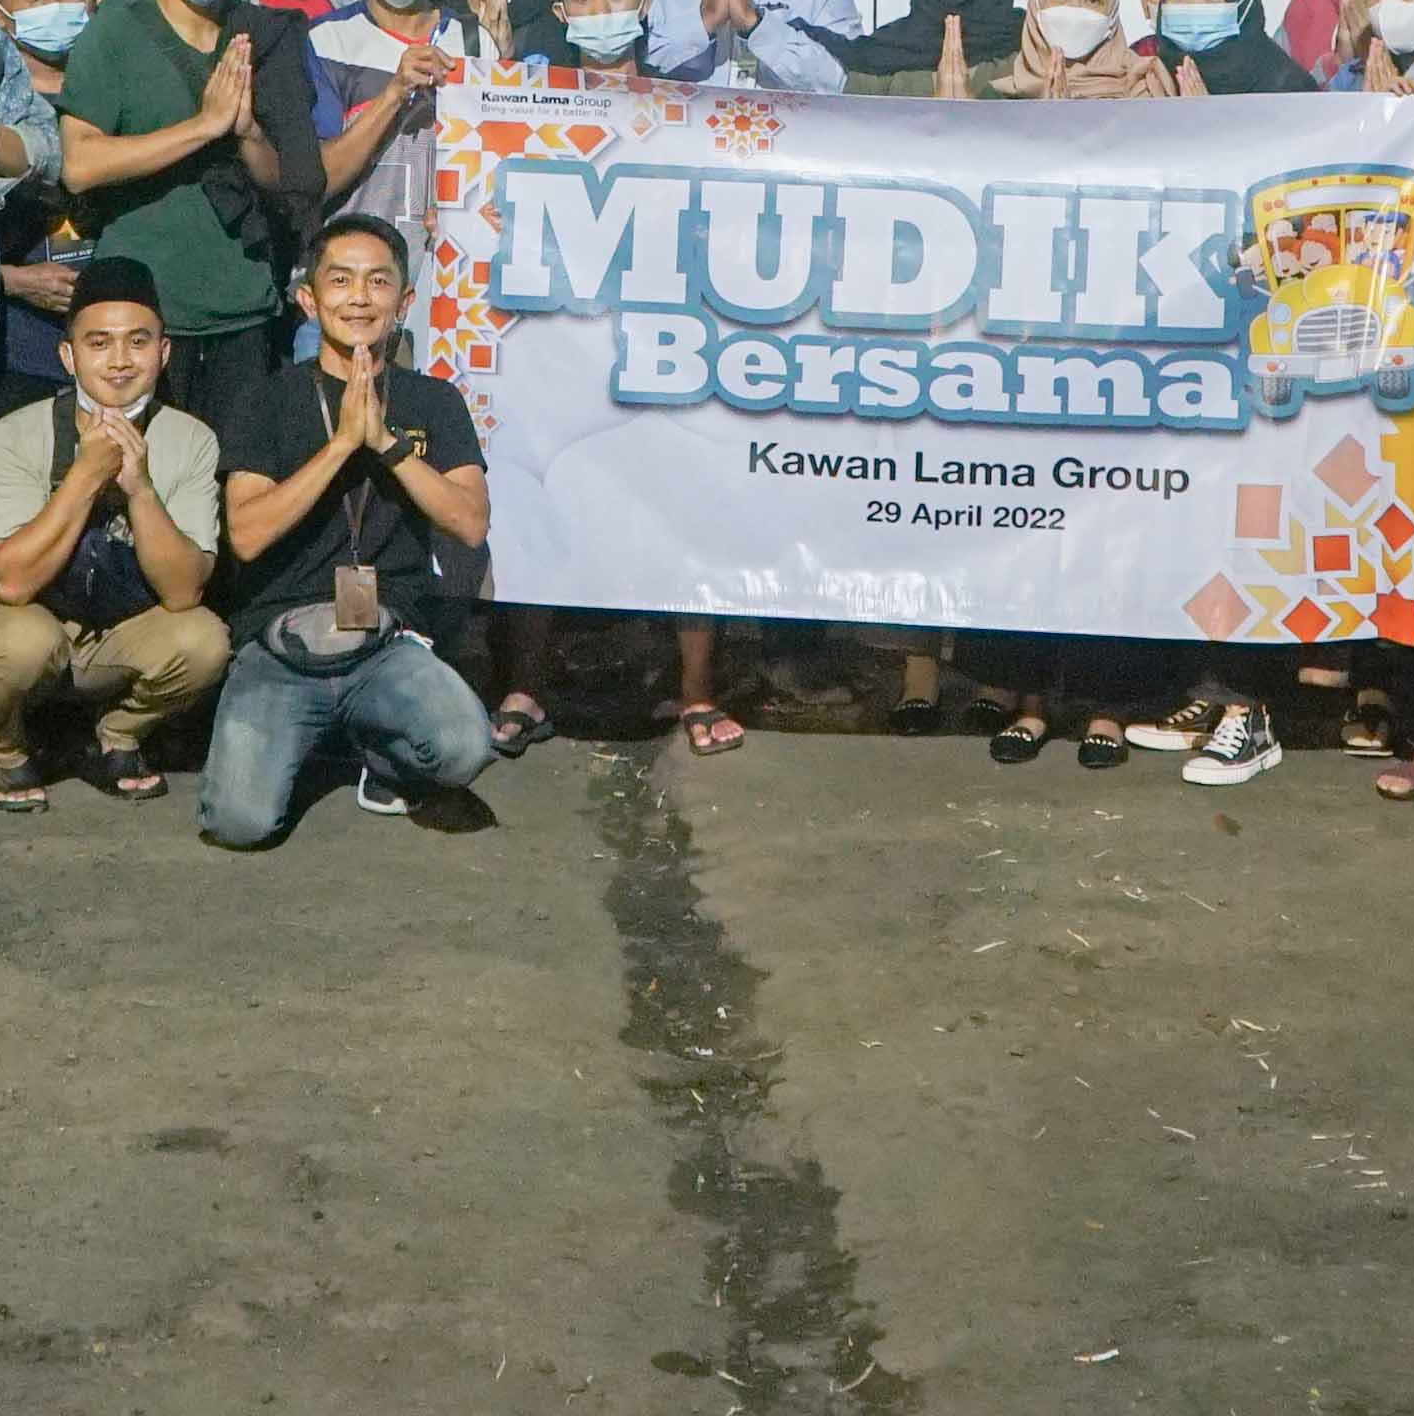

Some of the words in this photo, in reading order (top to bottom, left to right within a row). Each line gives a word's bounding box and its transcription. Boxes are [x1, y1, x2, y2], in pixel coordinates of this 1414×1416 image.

[481, 91, 528, 104] Kawan
[532, 93, 570, 105] Lama
[573, 95, 612, 109] Group
[500, 171, 1227, 329] MUDIK
[616, 311, 1241, 421] Bersama
[748, 440, 897, 482] Kawan
[914, 450, 1036, 488] Lama
[1052, 456, 1191, 500] Group
[866, 500, 903, 524] 29
[910, 503, 983, 531] April
[992, 506, 1067, 531] 2022
